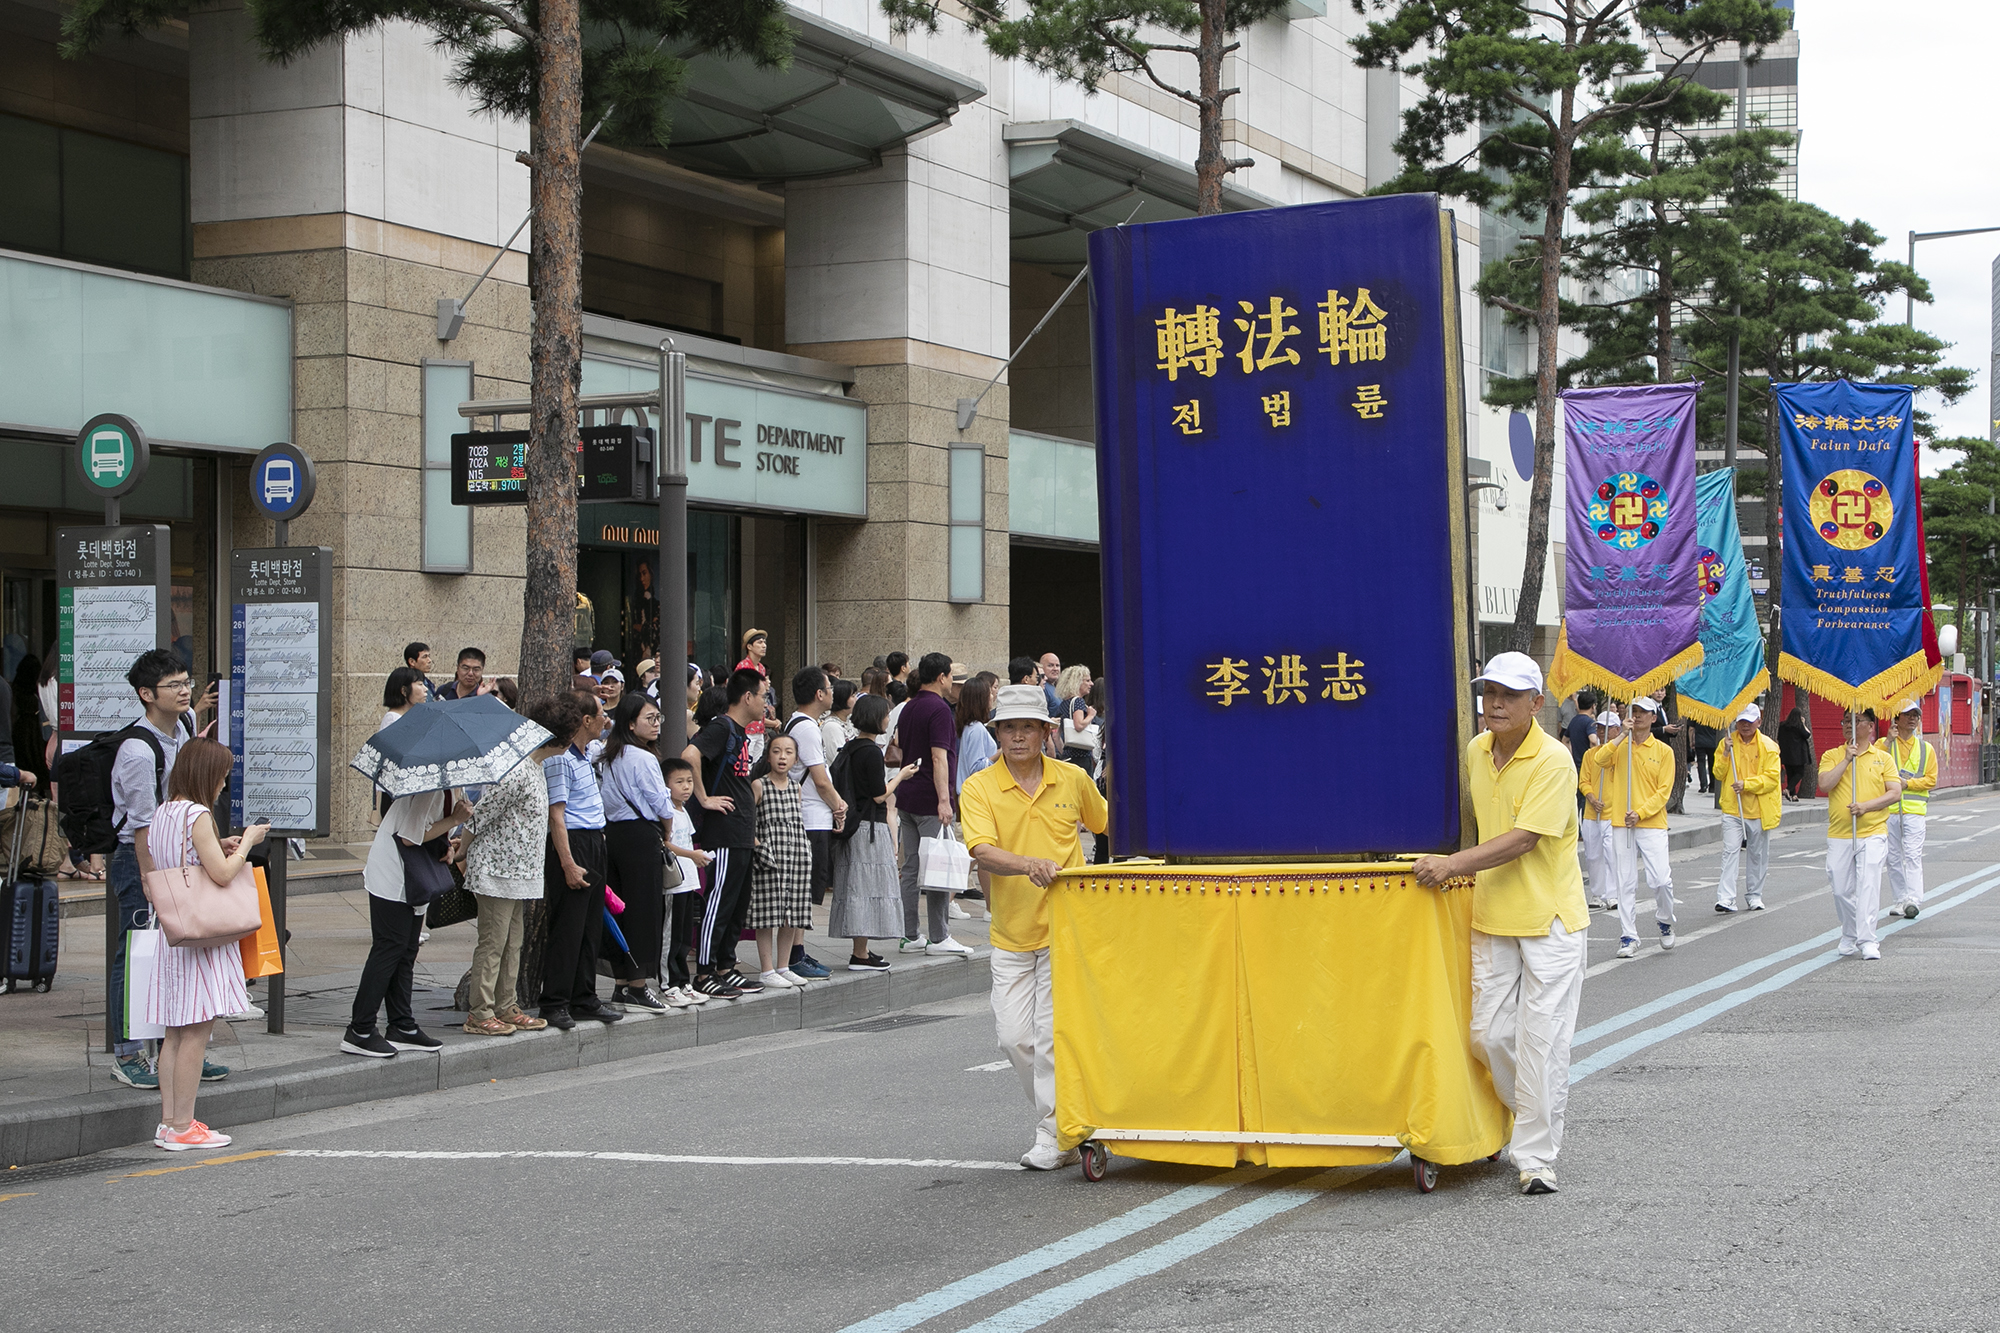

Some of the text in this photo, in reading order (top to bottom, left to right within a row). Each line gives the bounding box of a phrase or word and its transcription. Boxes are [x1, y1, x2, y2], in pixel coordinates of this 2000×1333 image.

[1155, 287, 1388, 382] 轉法輪
[1794, 414, 1903, 431] 法輪大法
[757, 423, 845, 455] DEPARTMENT
[1811, 438, 1891, 454] Falun Dafa
[468, 457, 489, 468] 702A
[757, 452, 800, 475] STORE
[468, 469, 484, 480] N15
[77, 539, 137, 560] 롯데백화점
[84, 560, 98, 568] Lotte
[116, 560, 130, 568] Store
[249, 559, 303, 578] 롯데백화점
[114, 569, 136, 577] 02-140
[284, 578, 296, 586] Store
[1816, 588, 1891, 601] Truthfulness
[60, 606, 74, 614] 7017
[1818, 603, 1888, 616] Compassion
[233, 621, 246, 629] 261
[1817, 618, 1891, 629] Forbearance
[60, 654, 74, 662] 7021
[232, 665, 246, 674] 262
[1206, 652, 1367, 706] 李洪志
[60, 701, 75, 710] 9701
[231, 709, 244, 718] 405
[231, 799, 243, 808] 701
